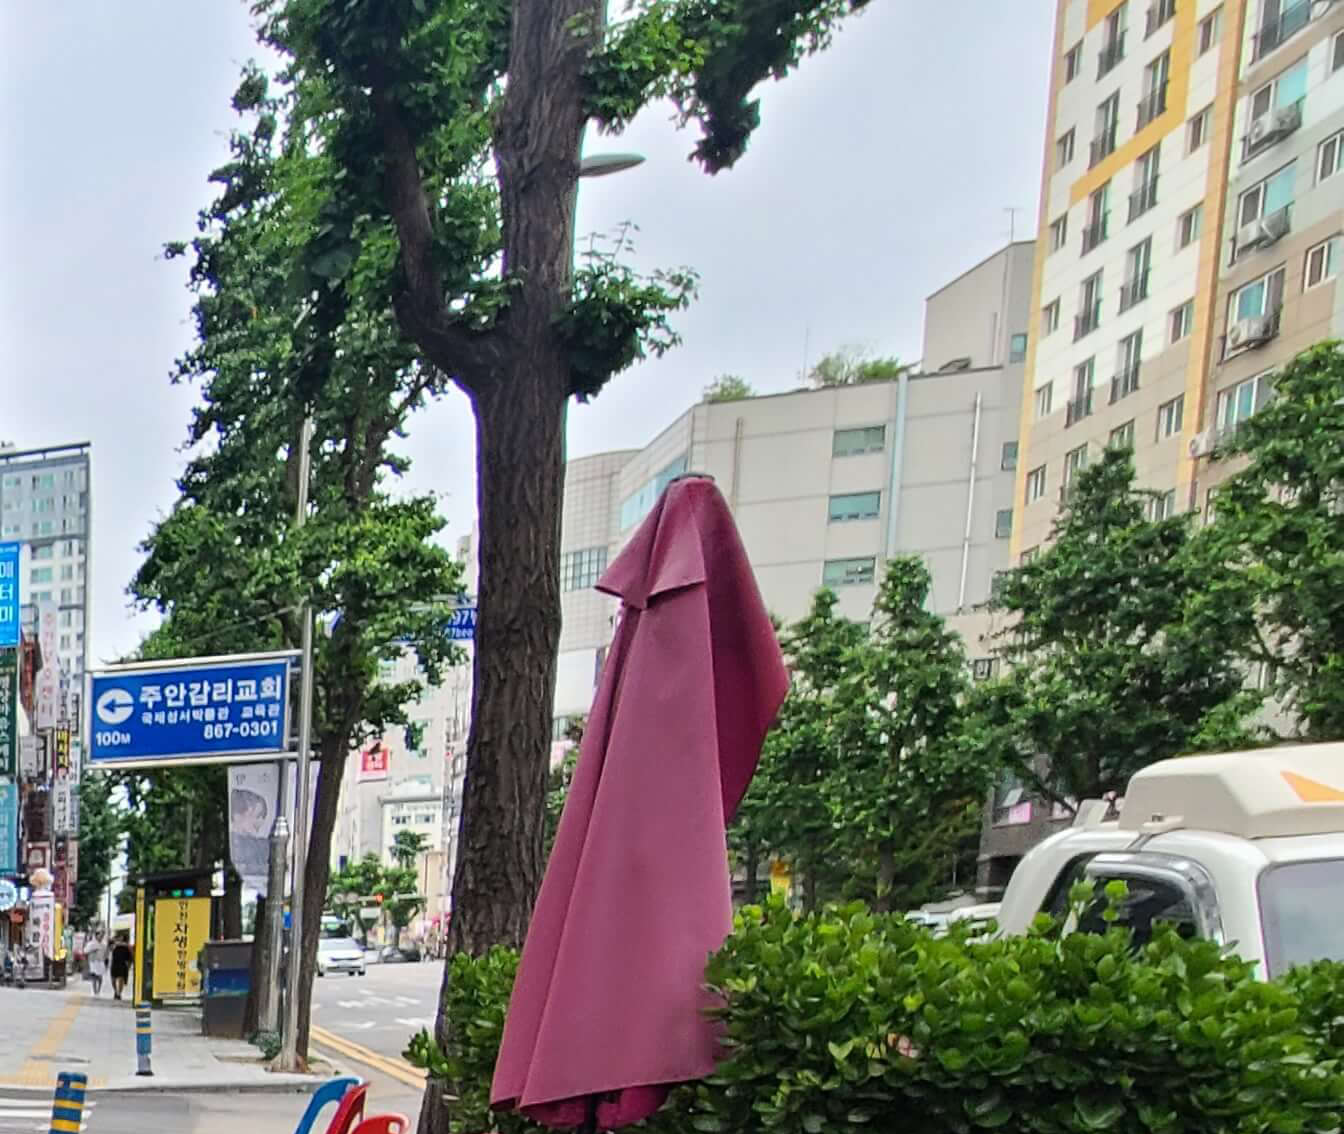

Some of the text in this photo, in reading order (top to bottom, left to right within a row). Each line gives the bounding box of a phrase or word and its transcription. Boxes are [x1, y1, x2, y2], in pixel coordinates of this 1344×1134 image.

[139, 675, 281, 709] 주안감리교회
[96, 731, 131, 746] 100M
[204, 720, 278, 739] 867-0301
